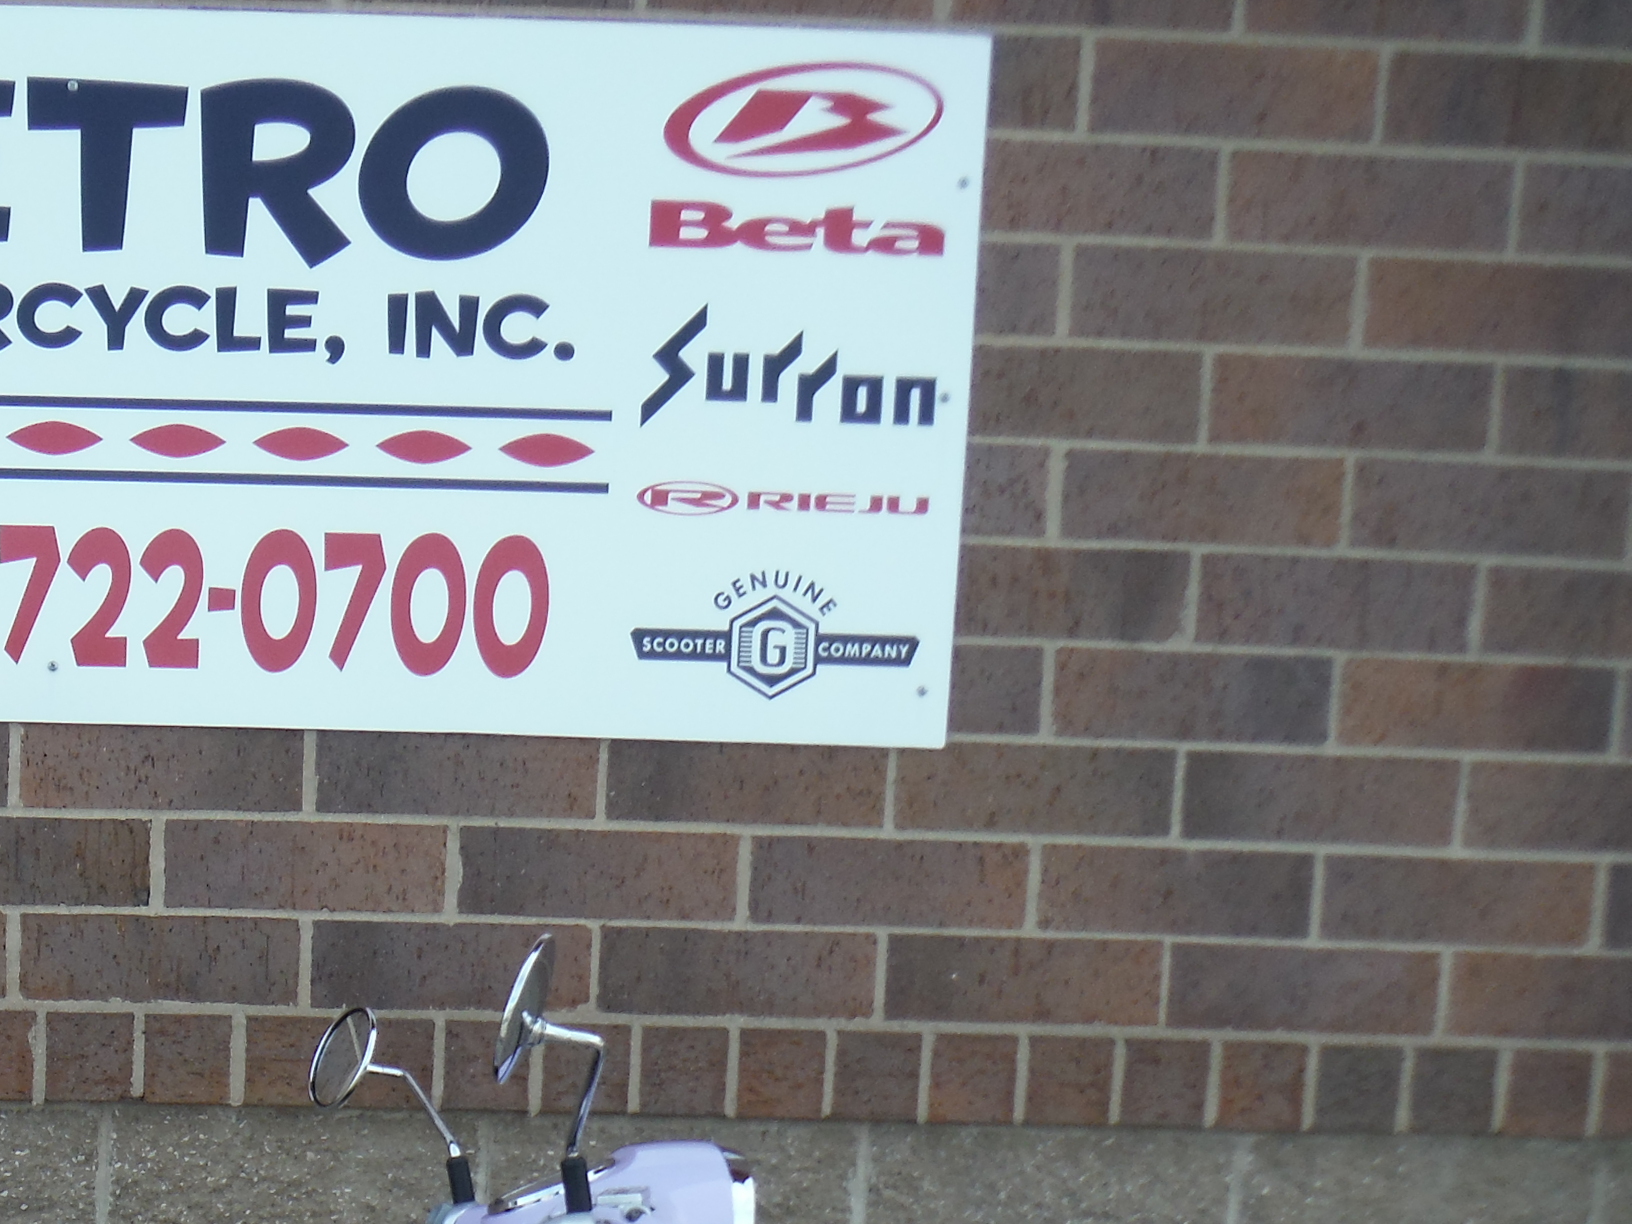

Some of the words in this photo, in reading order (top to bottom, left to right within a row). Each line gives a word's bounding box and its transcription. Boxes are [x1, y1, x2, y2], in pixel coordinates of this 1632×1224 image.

[649, 199, 945, 256] Beta
[386, 290, 575, 361] INC.
[746, 491, 930, 515] RIEJU
[713, 570, 837, 617] GENUINE
[642, 636, 726, 655] SCOOTER
[759, 626, 787, 668] G
[818, 641, 910, 661] COMPANY
